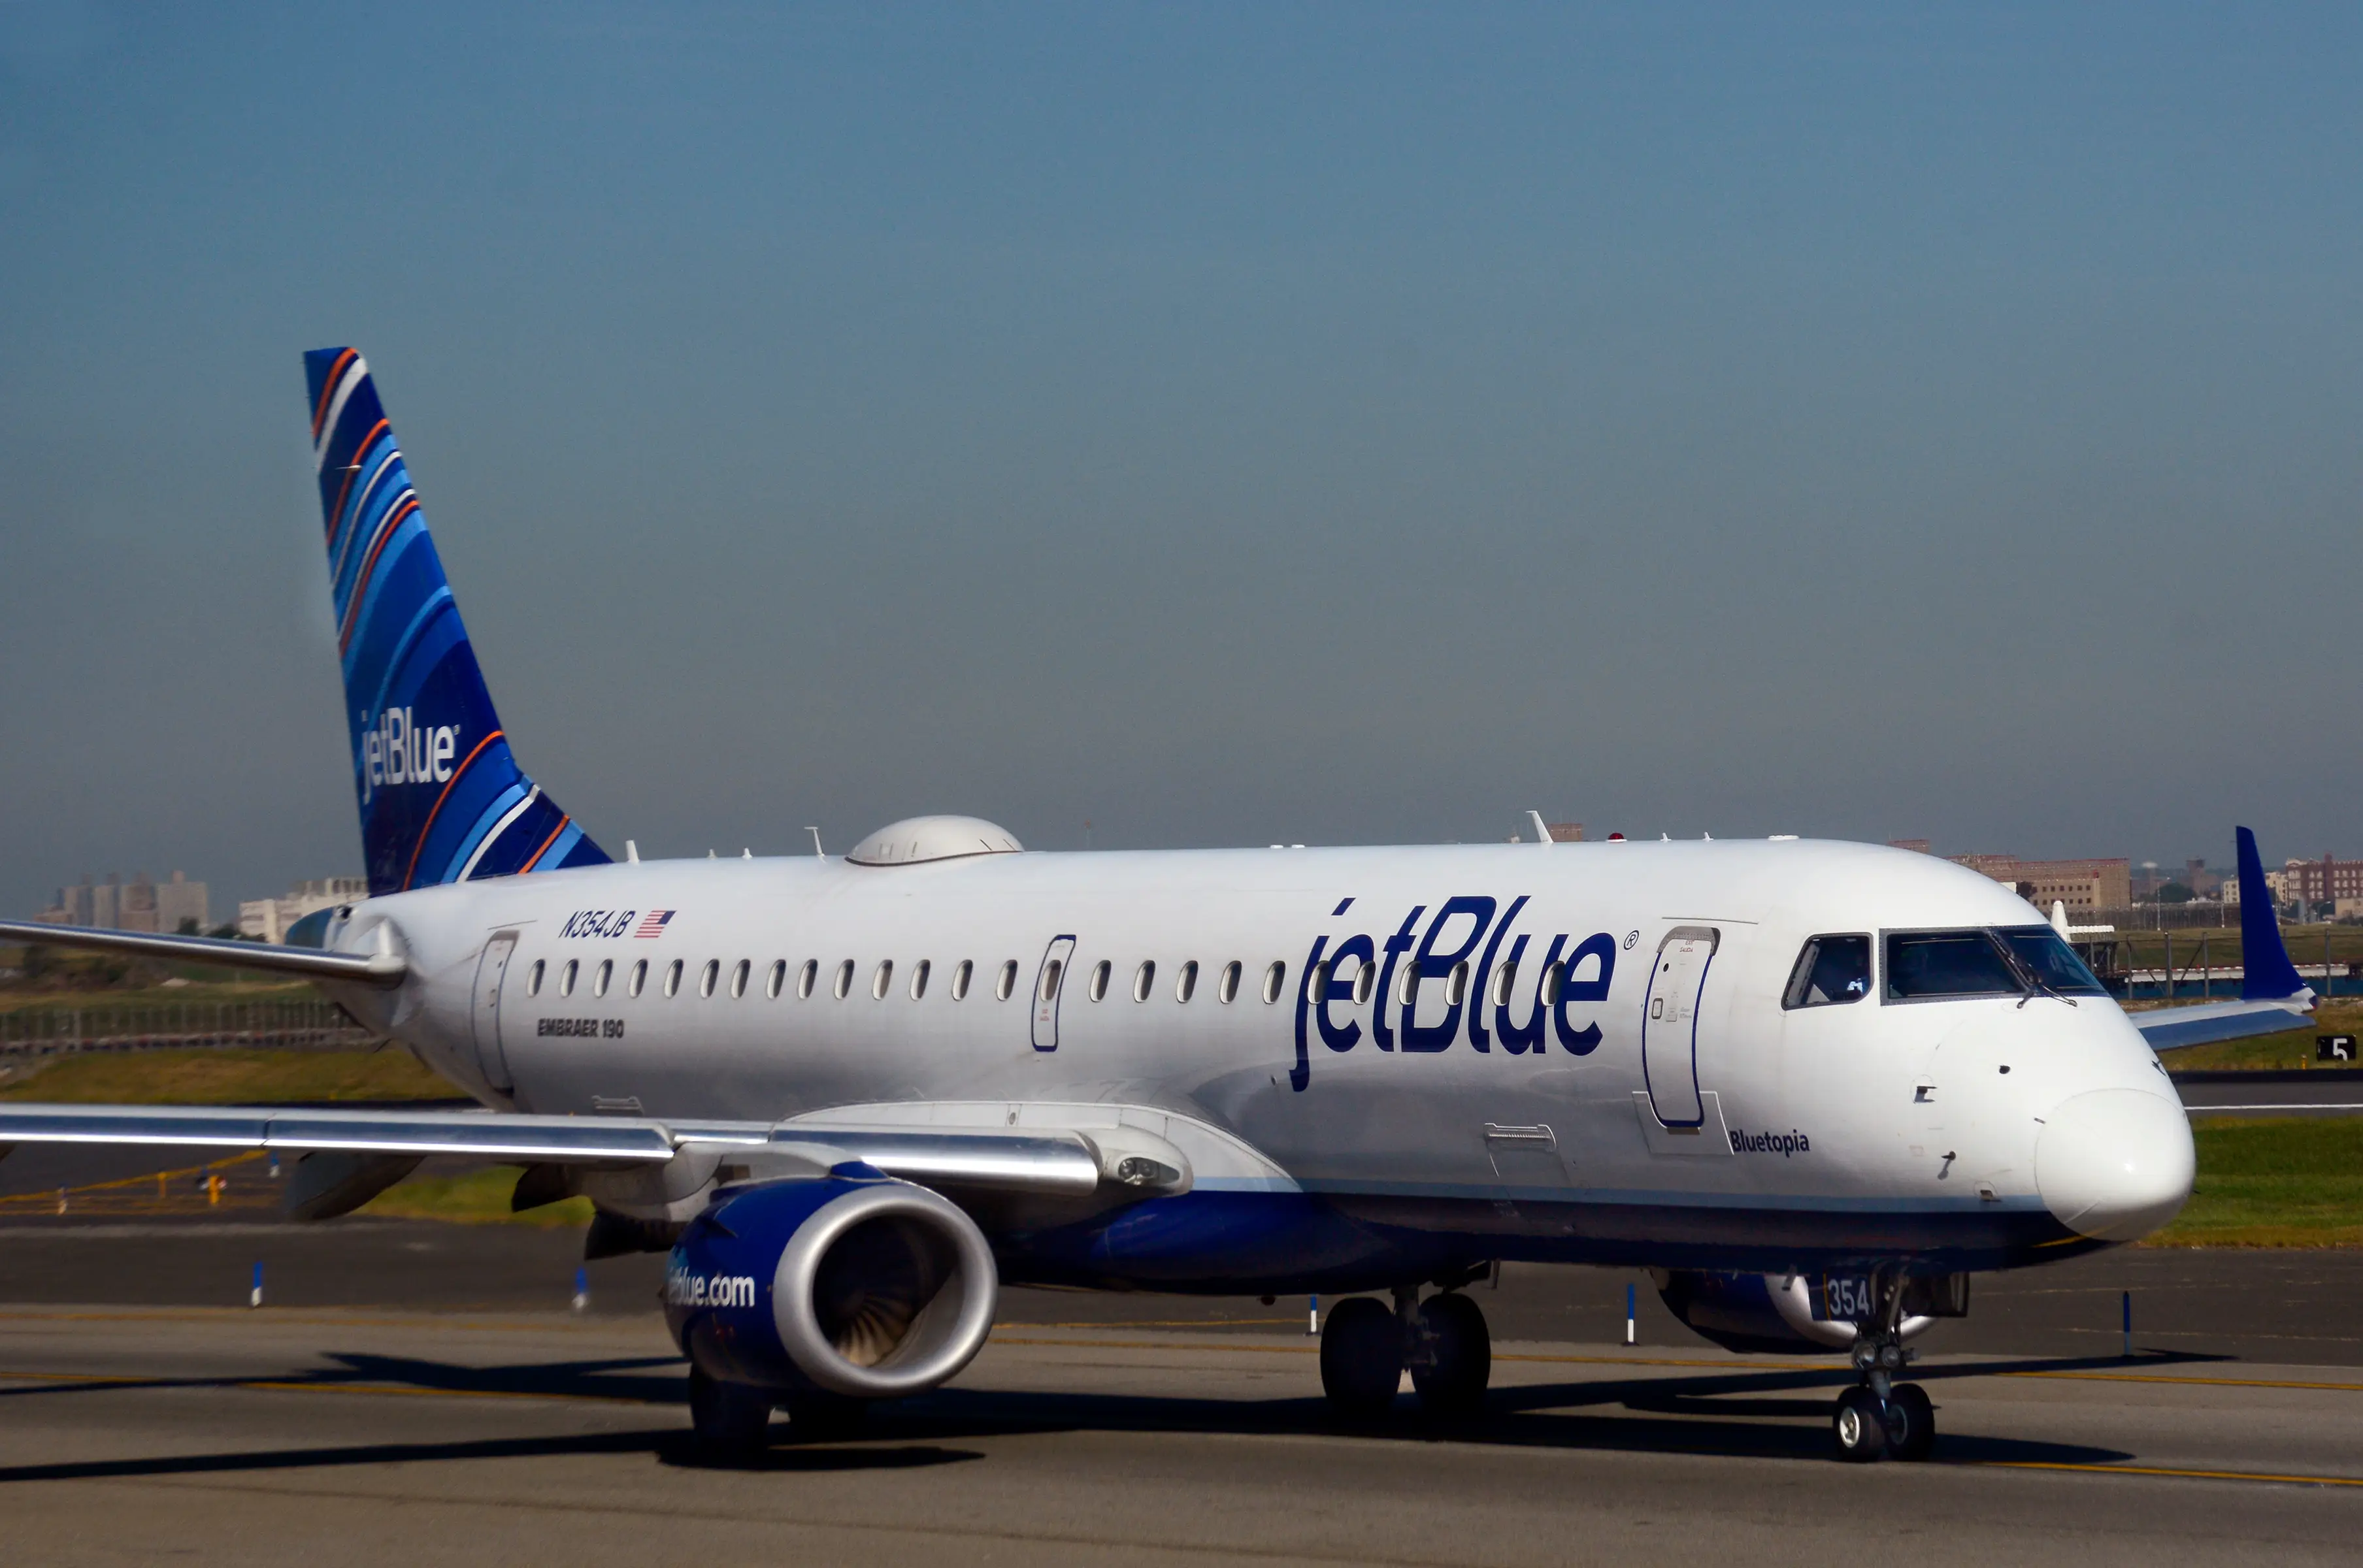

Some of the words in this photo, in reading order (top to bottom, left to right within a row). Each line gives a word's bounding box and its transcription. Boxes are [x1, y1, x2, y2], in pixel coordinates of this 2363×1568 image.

[558, 910, 636, 938] N354JB
[537, 1018, 599, 1037] EMBRAER
[603, 1019, 624, 1039] 190
[2333, 1037, 2348, 1062] 5
[1729, 1129, 1810, 1158] Bluetopia
[1828, 1279, 1870, 1316] 354
